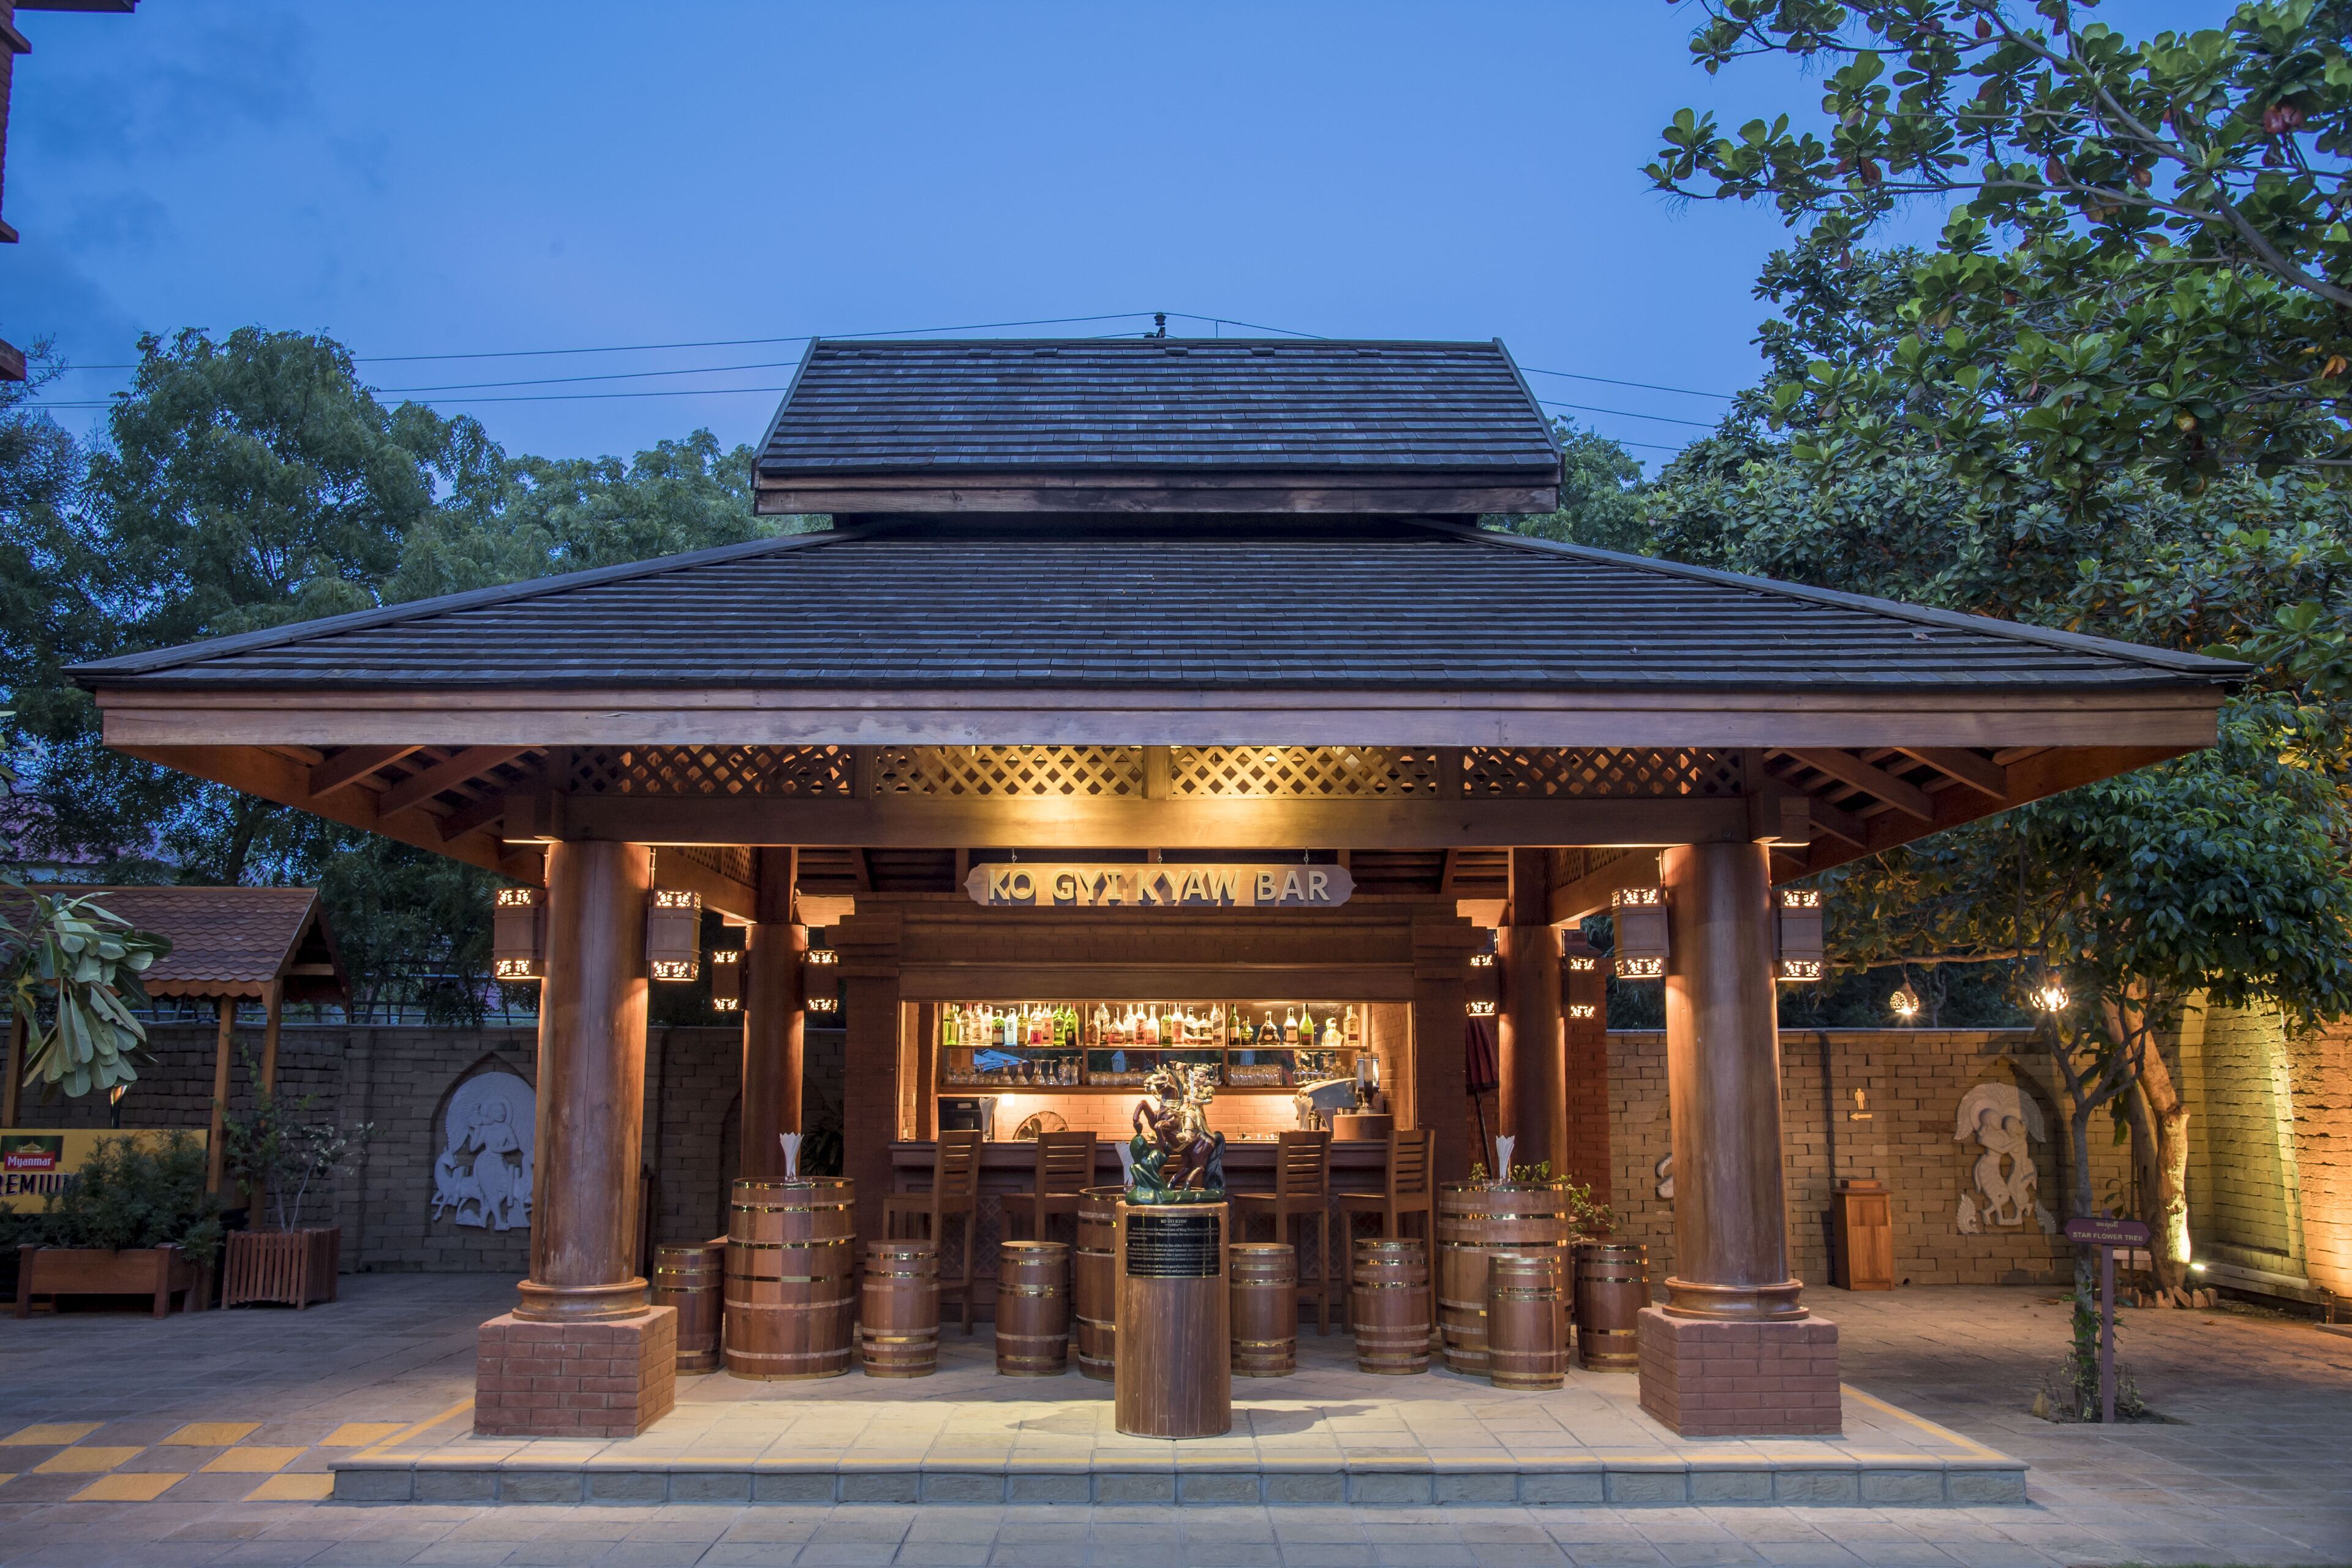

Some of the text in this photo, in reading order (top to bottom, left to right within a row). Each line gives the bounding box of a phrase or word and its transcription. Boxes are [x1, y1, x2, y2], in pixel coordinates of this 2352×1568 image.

[989, 870, 1330, 901] KO GYI KYAW BAR
[7, 1156, 52, 1168] Myanmar
